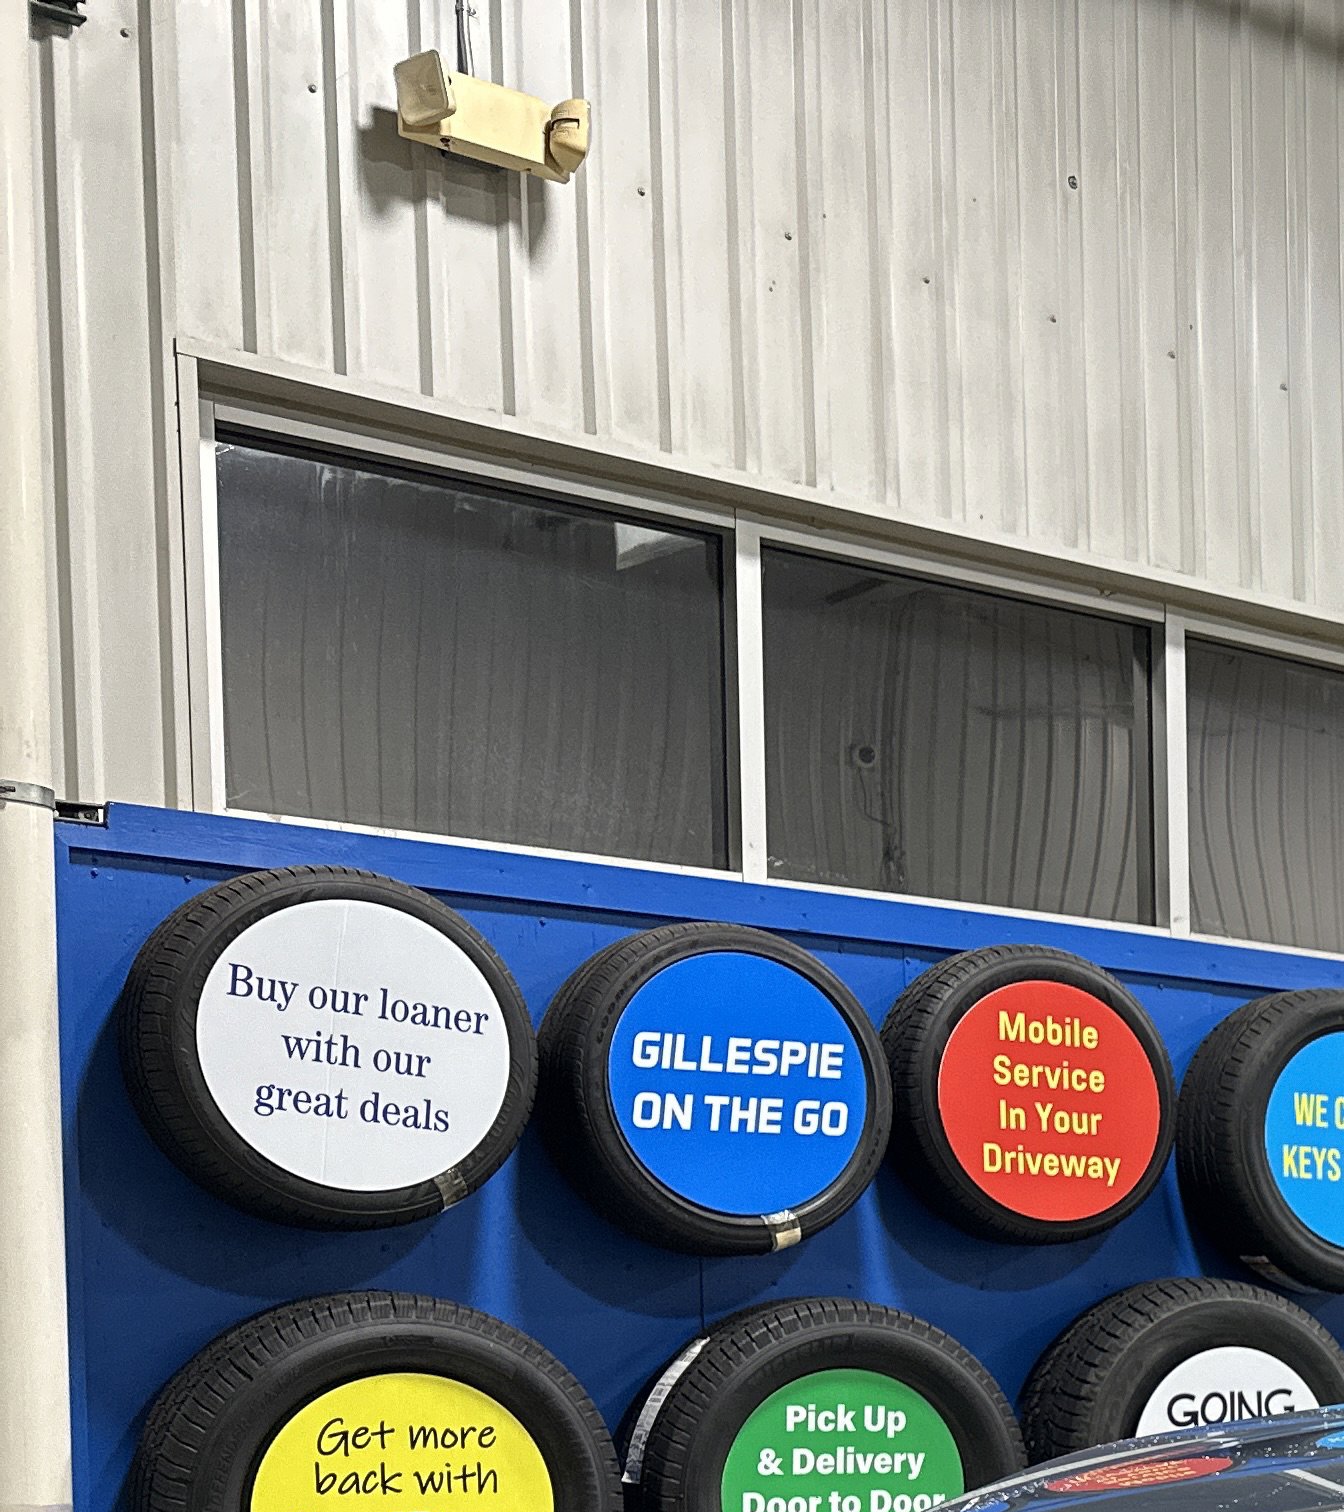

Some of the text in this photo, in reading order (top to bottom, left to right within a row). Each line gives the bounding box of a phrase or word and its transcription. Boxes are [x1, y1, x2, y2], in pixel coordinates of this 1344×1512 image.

[227, 963, 488, 1034] Buy our loaner
[998, 1011, 1099, 1048] Mobile
[281, 1031, 431, 1077] with our
[633, 1032, 844, 1078] GILLESPIE
[994, 1055, 1104, 1092] Service
[254, 1084, 449, 1132] great deals
[633, 1092, 849, 1137] ON THE GO
[999, 1100, 1103, 1135] In Your
[1294, 1093, 1328, 1128] WE
[984, 1143, 1120, 1186] Driveway
[1283, 1145, 1341, 1181] KEYS
[787, 1404, 906, 1438] Pick Up
[1167, 1389, 1296, 1428] GOING
[317, 1418, 496, 1457] Get more
[315, 1462, 497, 1495] back with
[758, 1447, 925, 1480] & Delivery
